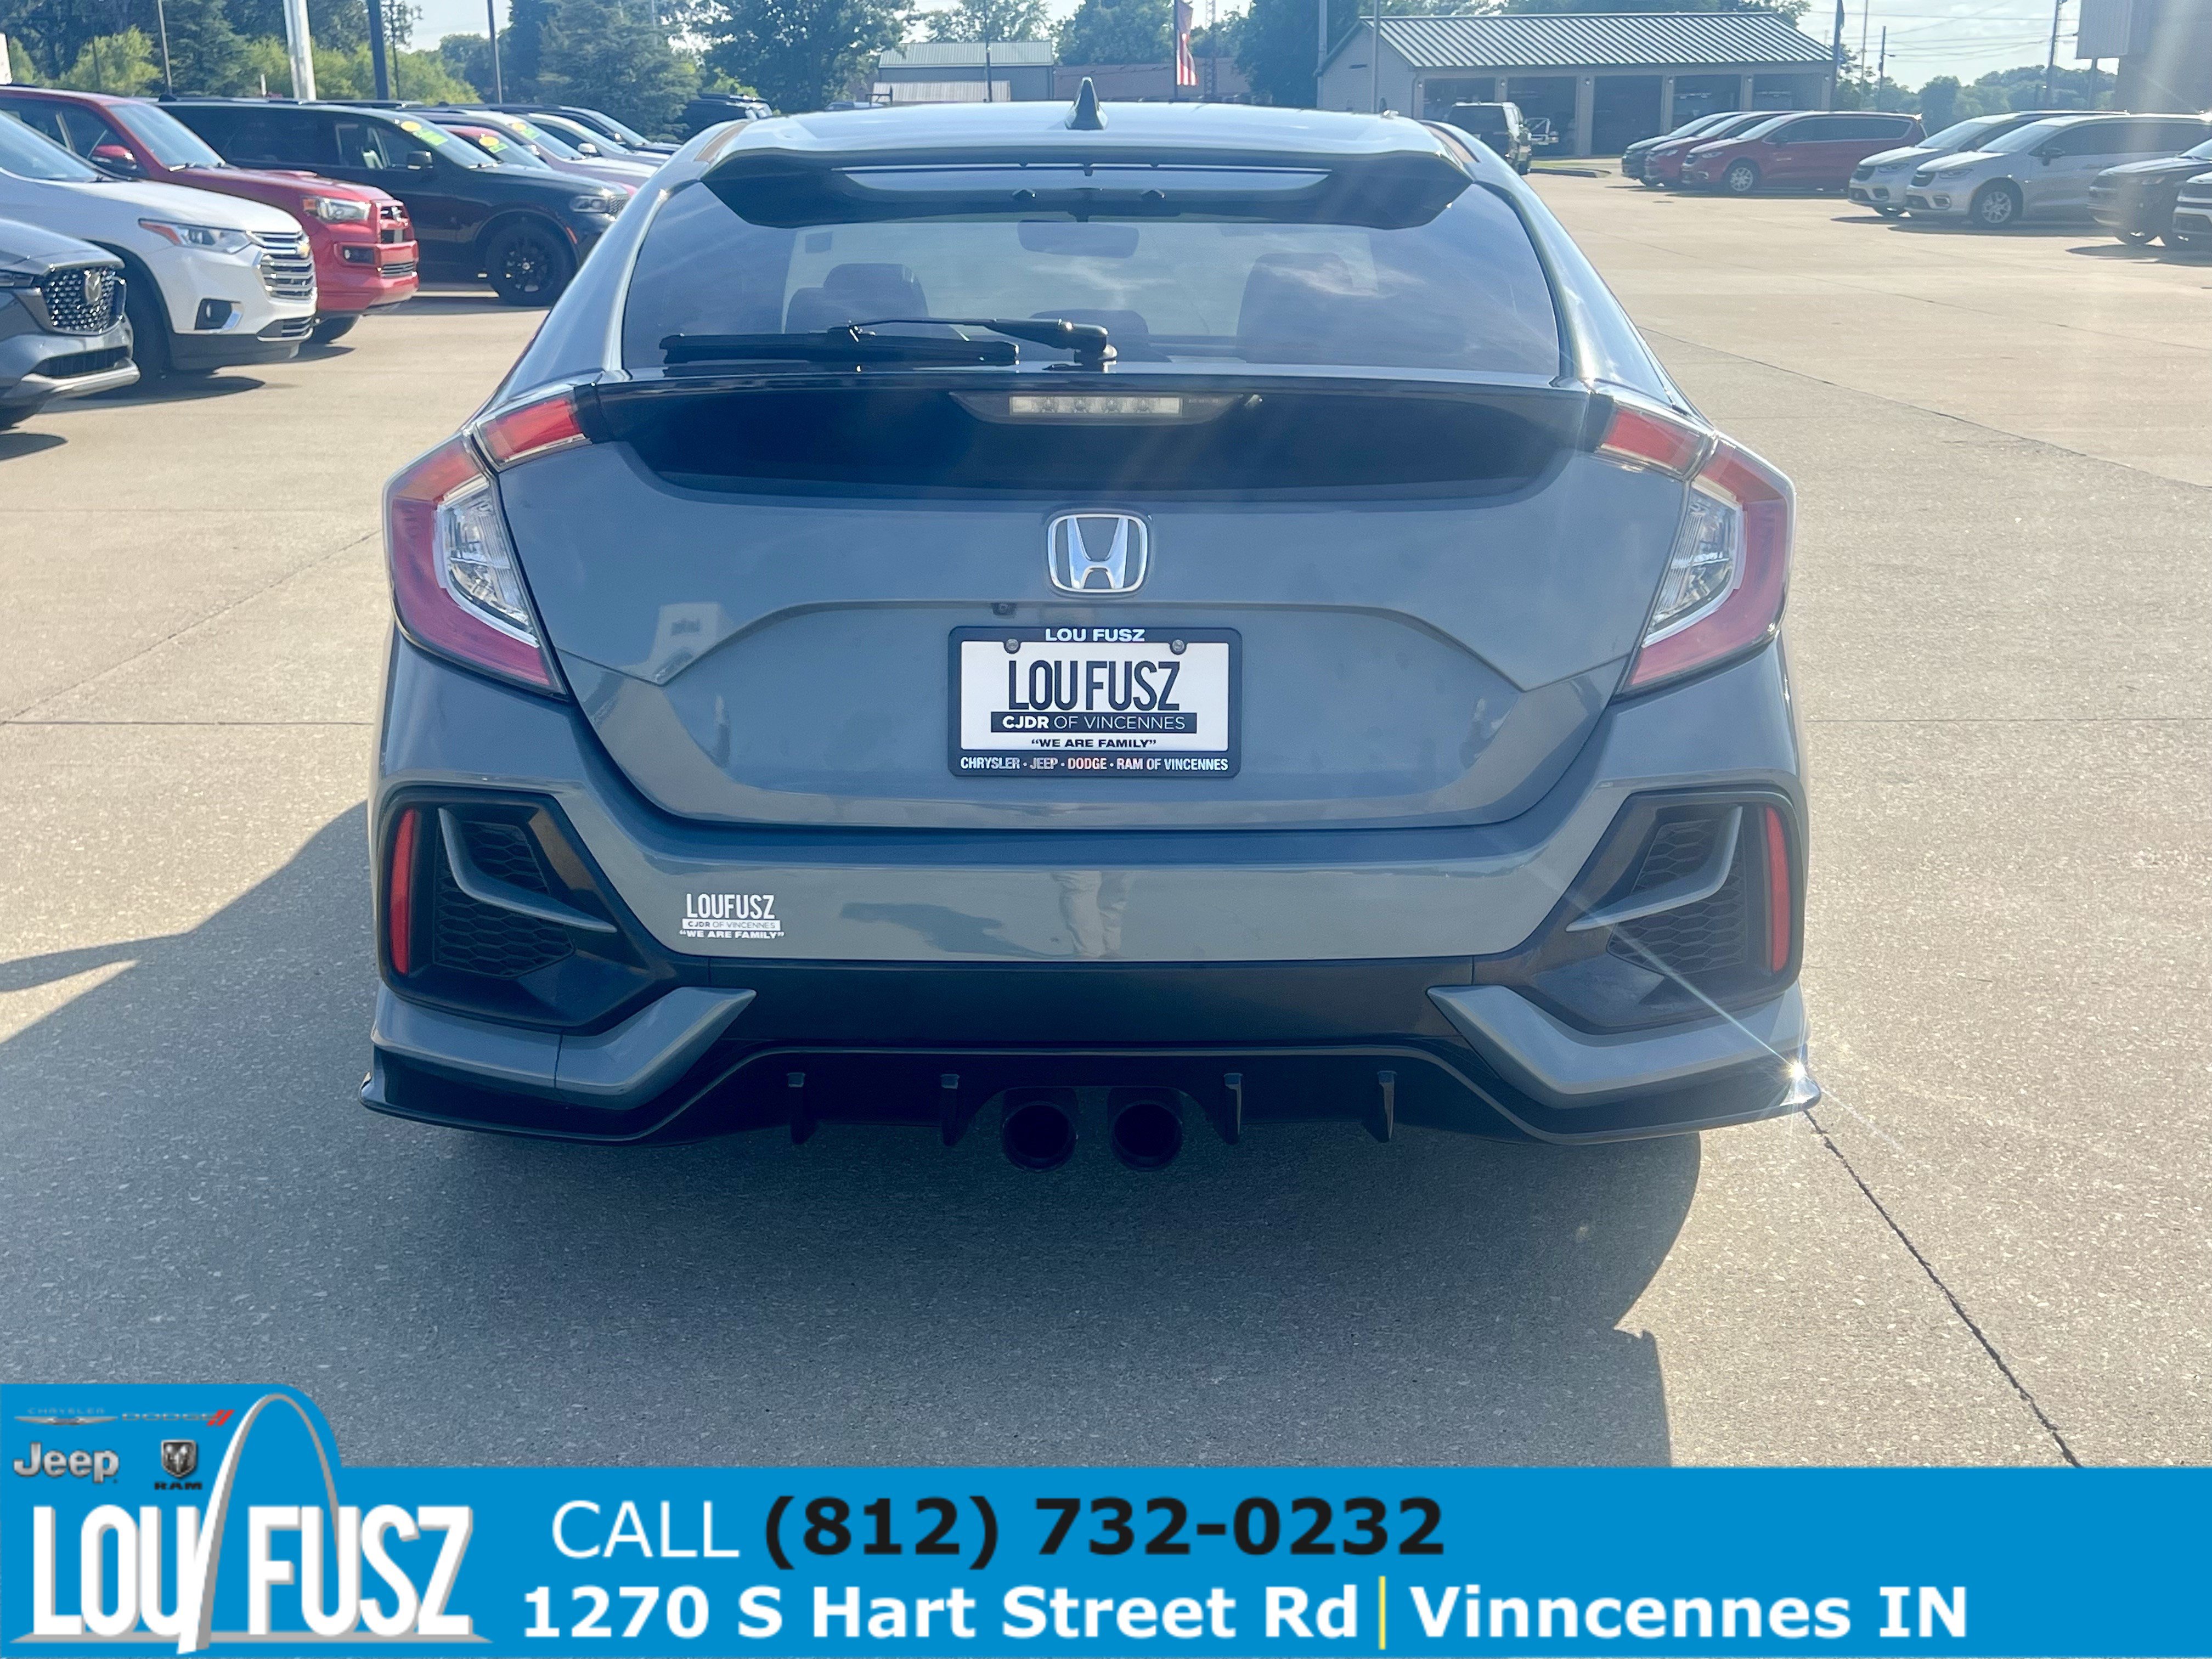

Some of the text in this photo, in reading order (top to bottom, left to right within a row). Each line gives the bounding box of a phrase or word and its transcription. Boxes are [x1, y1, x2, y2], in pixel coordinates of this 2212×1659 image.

[1046, 628, 1145, 642] LOU FUSZ
[1008, 659, 1181, 712] LOU FUSZ
[1002, 715, 1186, 730] CJDR OF VINCENNES
[1031, 738, 1157, 748] “WE ARE FAMILY”
[960, 757, 1228, 770] CHRYSLER JEEP DODGE RAM OF VINCENNES
[707, 930, 732, 939] ARE
